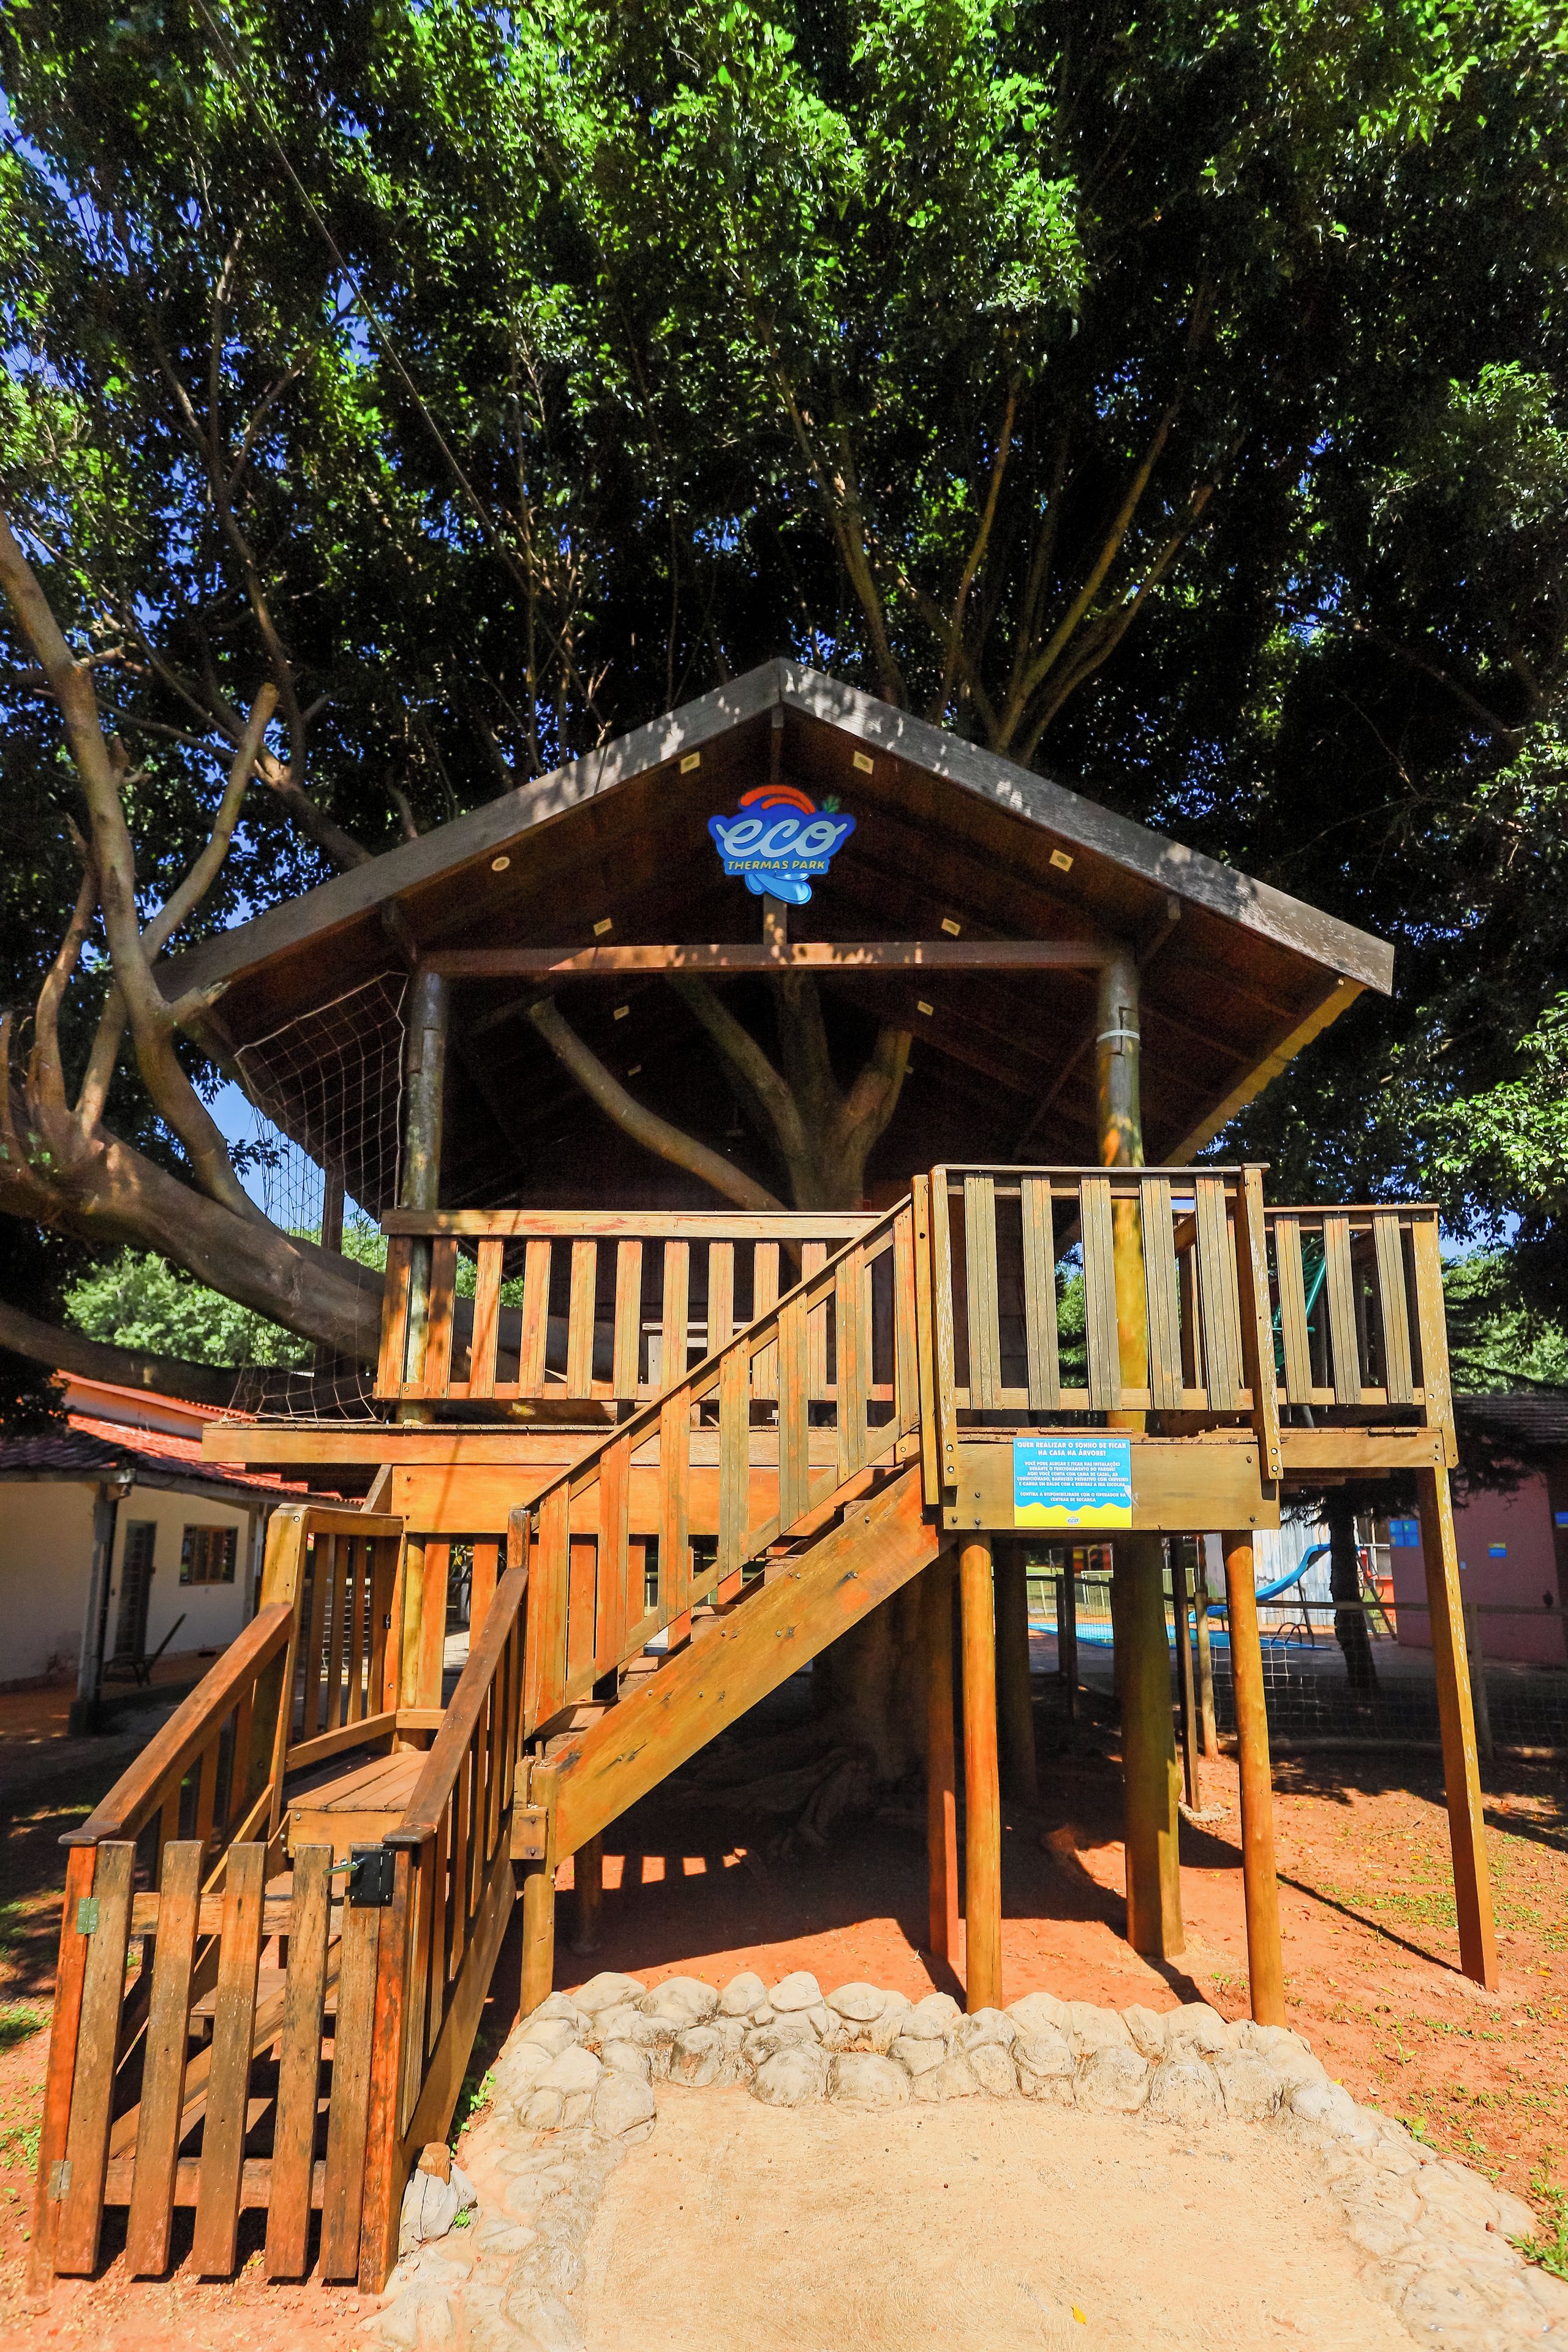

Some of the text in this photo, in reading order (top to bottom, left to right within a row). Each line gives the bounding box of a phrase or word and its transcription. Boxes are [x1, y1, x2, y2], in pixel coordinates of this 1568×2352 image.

[716, 819, 847, 858] eco
[728, 861, 825, 870] THERMAS PARK
